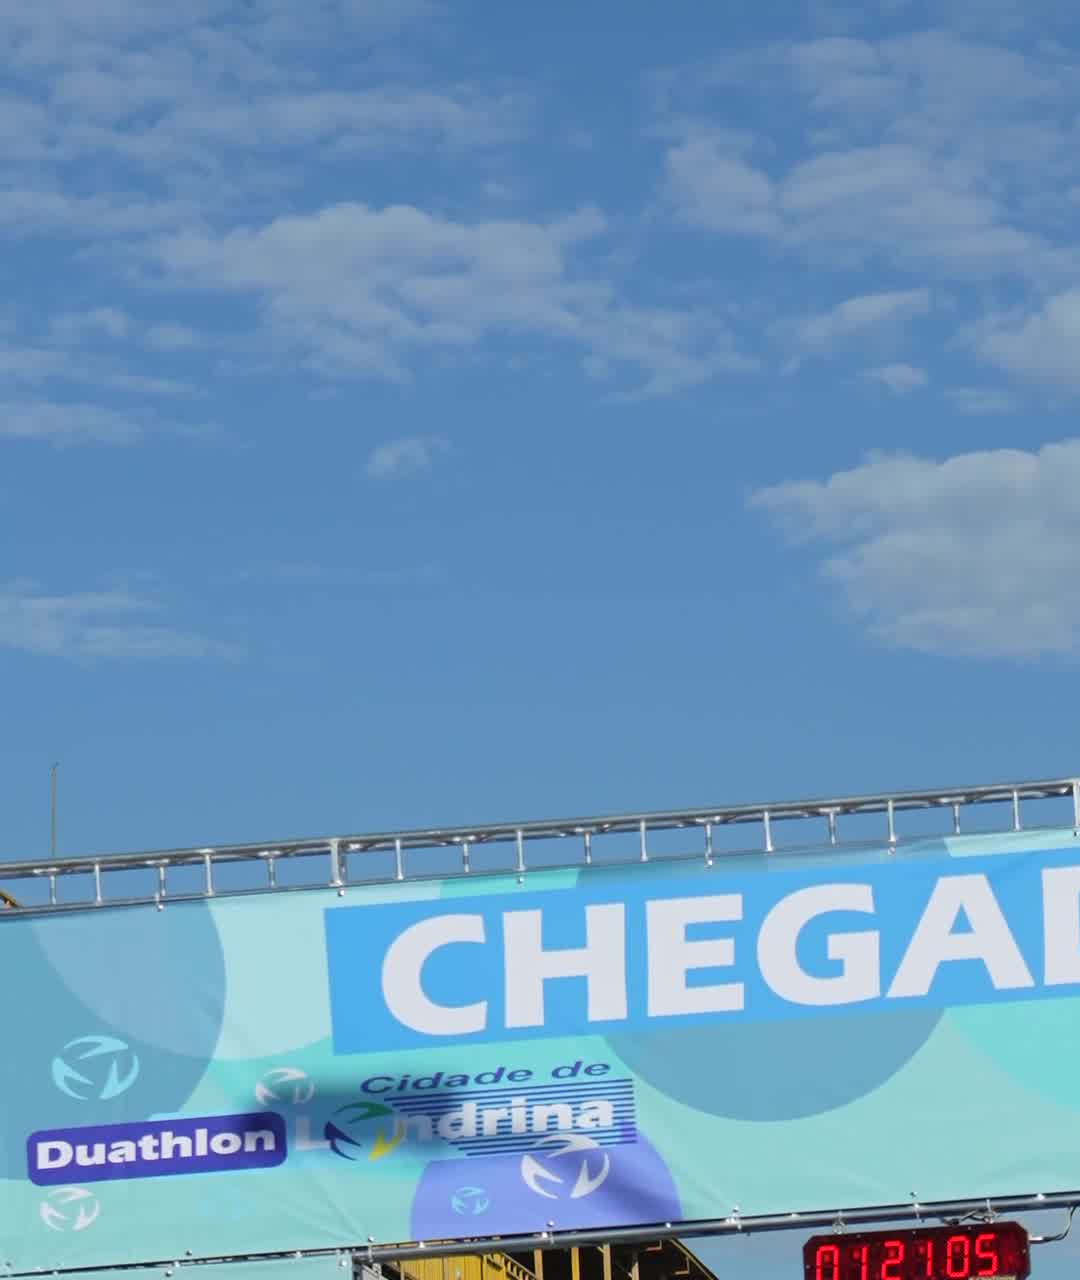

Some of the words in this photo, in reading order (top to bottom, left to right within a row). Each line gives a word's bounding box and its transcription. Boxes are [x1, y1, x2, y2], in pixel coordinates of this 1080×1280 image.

[361, 1064, 532, 1094] Cidade
[551, 1060, 610, 1081] de
[36, 1122, 276, 1170] Duathlon
